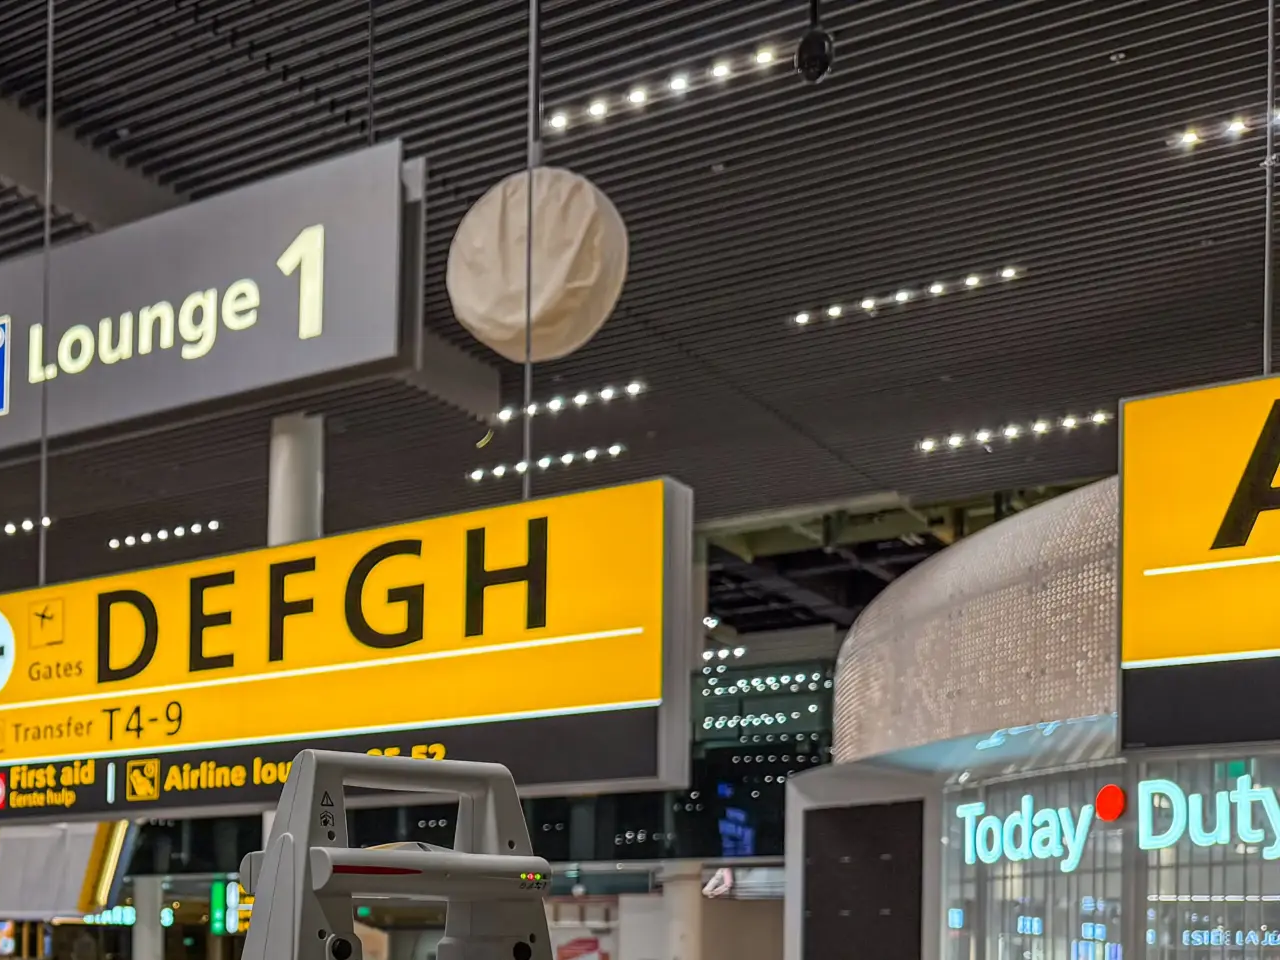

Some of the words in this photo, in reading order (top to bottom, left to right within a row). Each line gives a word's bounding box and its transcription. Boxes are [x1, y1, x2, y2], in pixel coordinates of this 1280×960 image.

[28, 277, 261, 384] Lounge
[276, 223, 325, 340] 1
[27, 658, 84, 682] Gates
[13, 716, 93, 743] Transfer
[101, 701, 183, 741] T4-9
[9, 764, 57, 790] First
[59, 759, 96, 786] aid
[163, 760, 246, 792] Airline
[253, 756, 293, 785] lou
[45, 788, 76, 807] hulp
[956, 794, 1094, 873] Today
